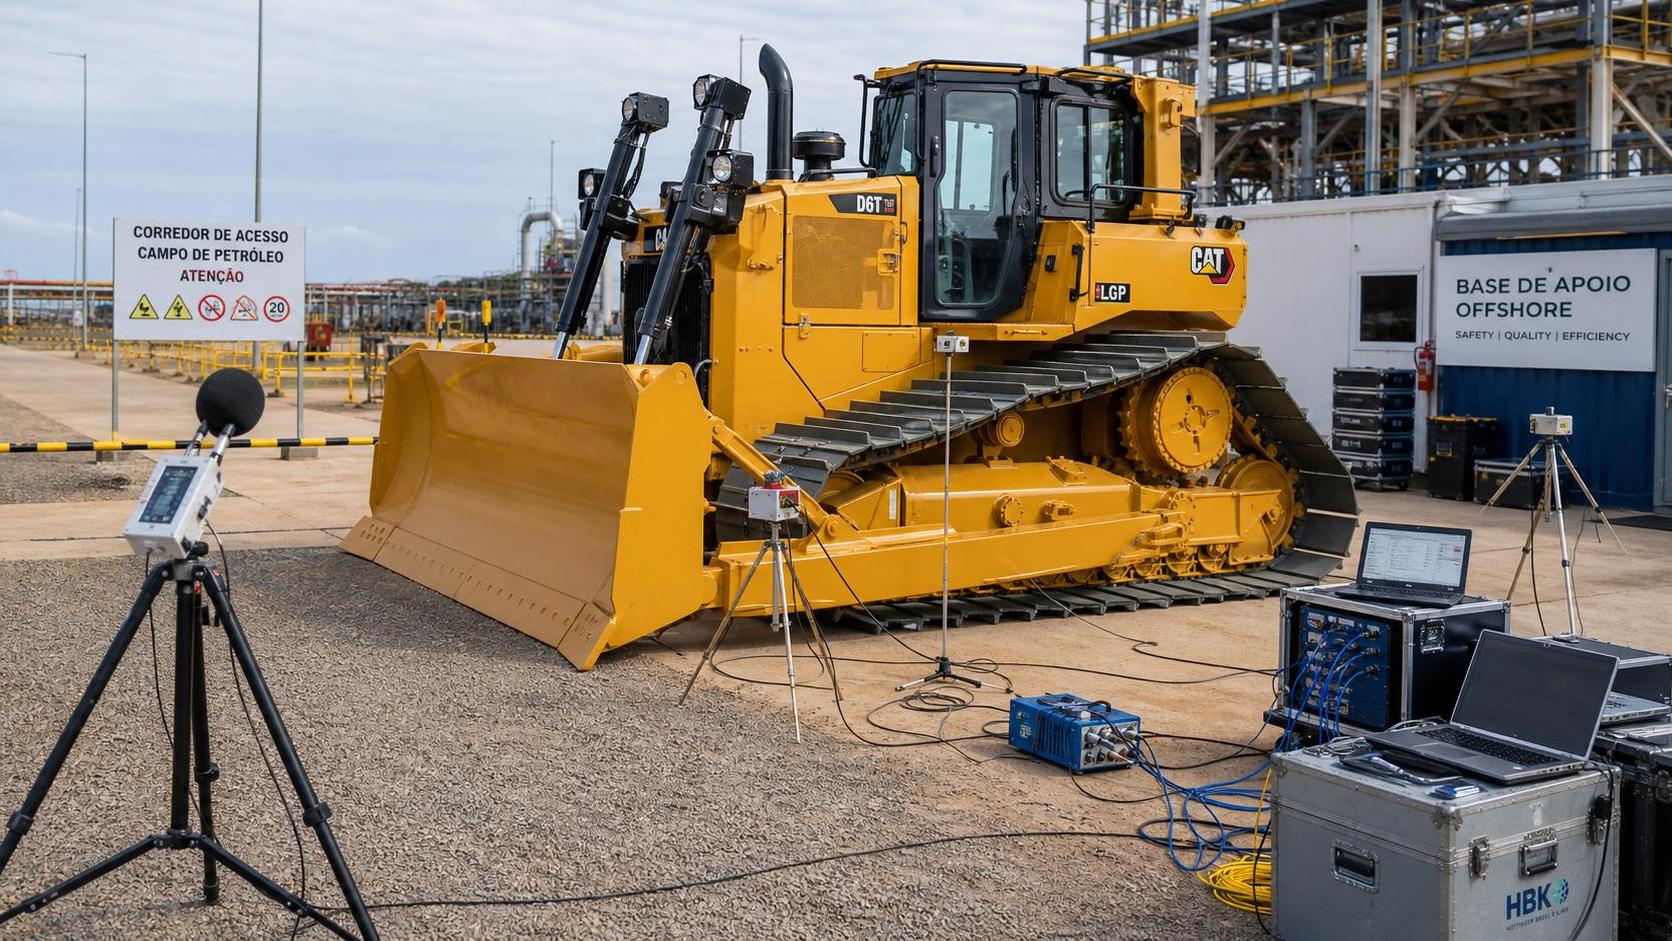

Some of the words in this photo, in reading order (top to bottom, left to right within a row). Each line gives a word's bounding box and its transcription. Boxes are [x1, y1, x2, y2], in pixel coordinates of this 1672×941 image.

[856, 194, 883, 213] D6T
[133, 226, 210, 240] CORREDOR
[214, 229, 231, 242] DE
[235, 230, 289, 243] ACESSO
[138, 247, 188, 260] CAMPO
[192, 249, 209, 261] DE
[214, 247, 284, 263] PETRÓLEO
[1191, 246, 1224, 274] CAT
[180, 268, 244, 284] ATENÇÃO
[1456, 278, 1511, 294] BASE
[1518, 277, 1547, 293] DE
[1554, 275, 1631, 293] APOIO
[1100, 284, 1127, 301] LGP
[269, 302, 285, 313] 20
[1456, 301, 1573, 318] OFFSHORE
[1455, 330, 1494, 340] SAFETY
[1504, 331, 1551, 341] QUALITY
[1562, 331, 1631, 342] EFFICIENCY
[1506, 883, 1552, 920] HBK
